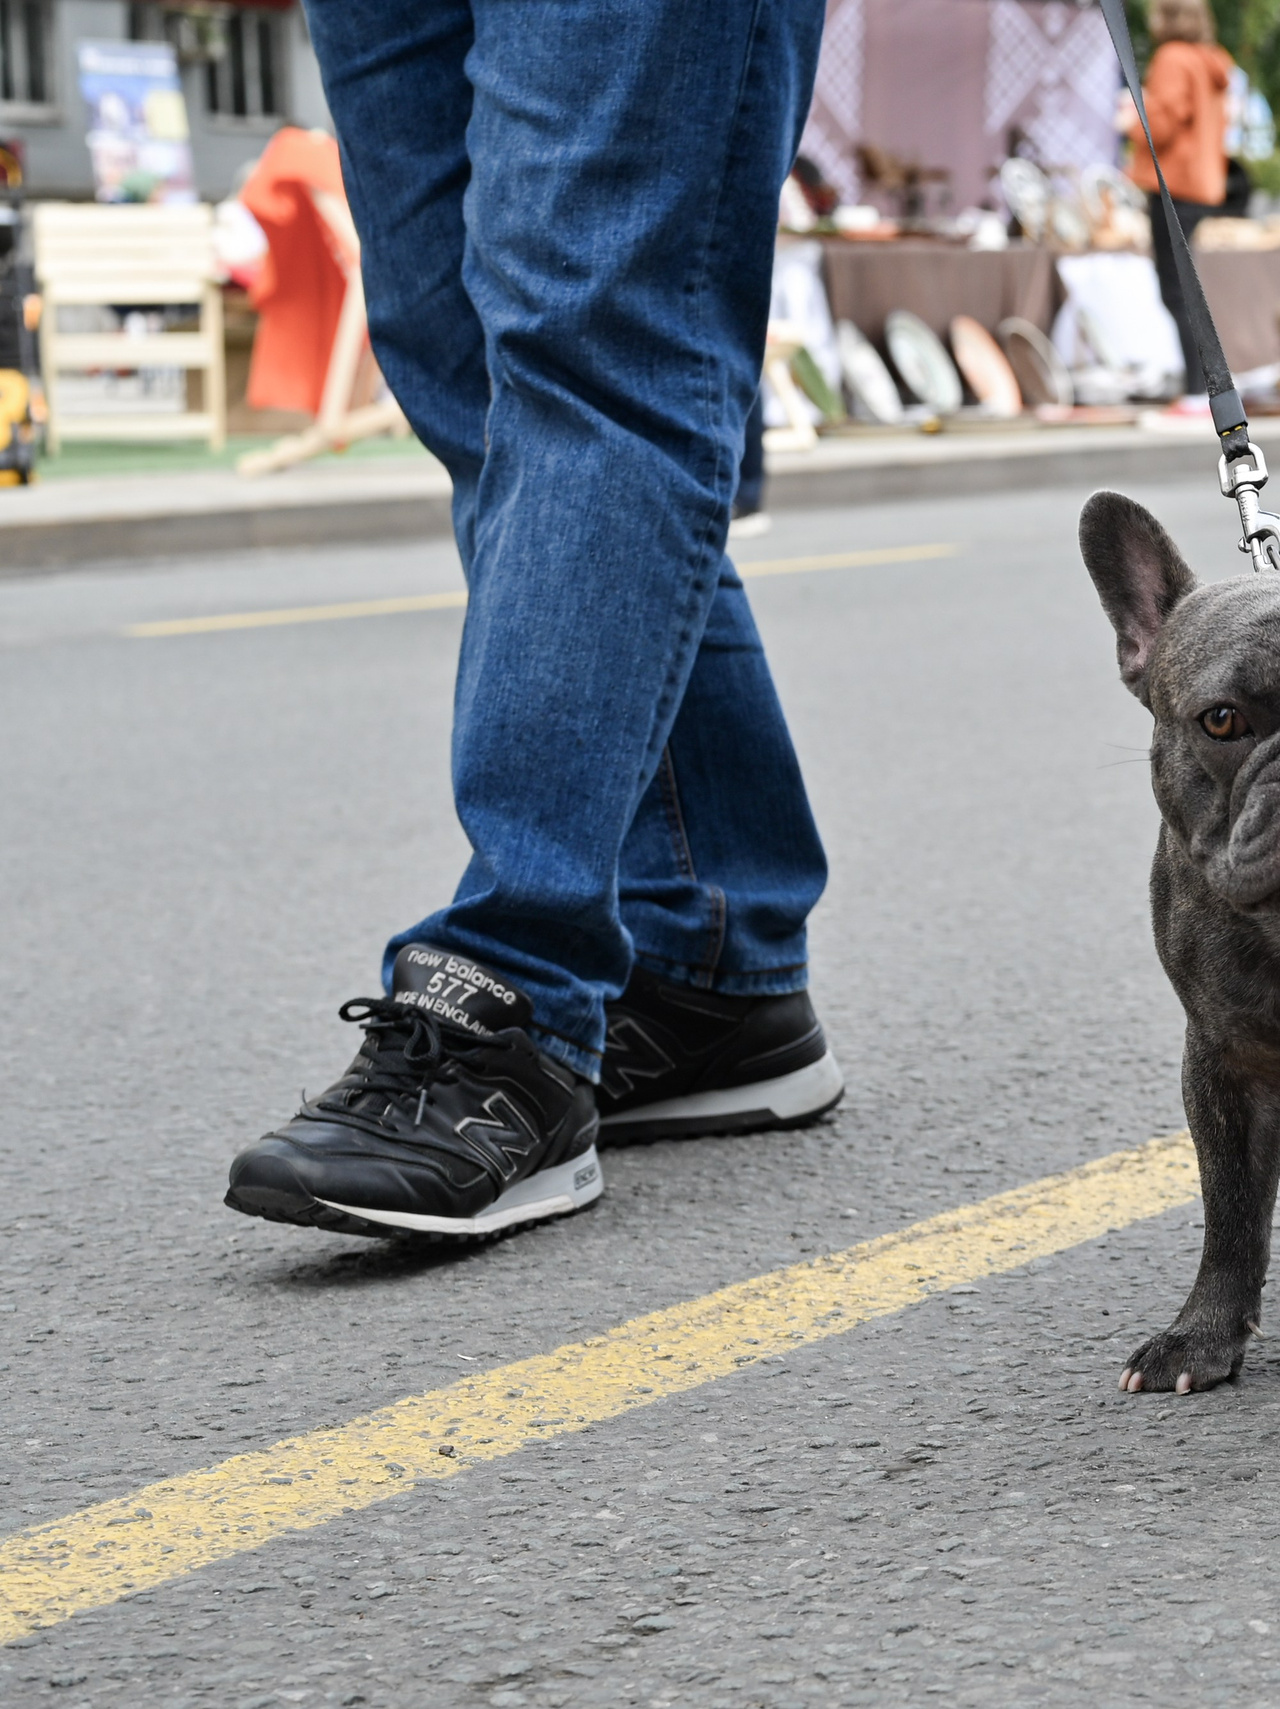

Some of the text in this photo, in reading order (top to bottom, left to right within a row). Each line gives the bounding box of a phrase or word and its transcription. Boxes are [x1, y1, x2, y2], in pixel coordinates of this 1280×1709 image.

[407, 950, 517, 1005] new balance
[426, 971, 478, 1005] 577
[417, 993, 435, 1010] IN
